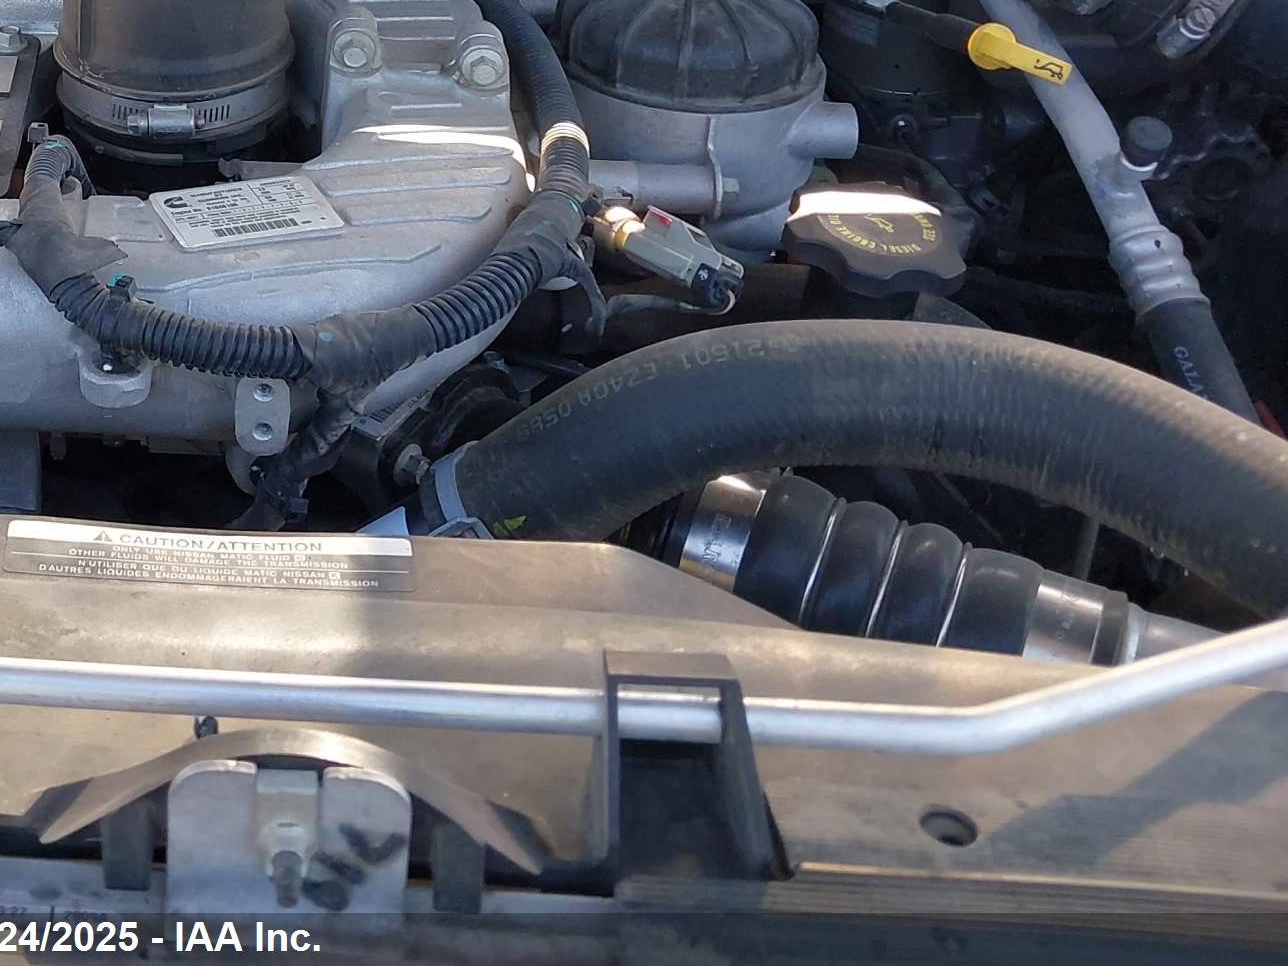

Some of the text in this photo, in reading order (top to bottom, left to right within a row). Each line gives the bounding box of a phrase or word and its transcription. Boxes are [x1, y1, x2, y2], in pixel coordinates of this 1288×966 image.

[682, 341, 765, 371] 21501
[119, 533, 322, 552] CAUTION/ATTENTION
[68, 548, 349, 570] OTHER FLUIDS WILL DAMAGE THE TRANSMISSION
[112, 545, 140, 554] ONLY
[173, 549, 216, 560] NISSAN
[220, 552, 254, 561] MATIC
[258, 553, 291, 562] FLUID
[97, 567, 150, 578] LIQUIDES
[273, 577, 287, 585] LA
[293, 577, 379, 589] TRANSMISSION
[142, 563, 167, 572] QUE
[171, 565, 188, 573] DU
[193, 567, 238, 576] LIQUIDE
[243, 569, 275, 578] MATIC
[282, 571, 326, 580] NISSAN
